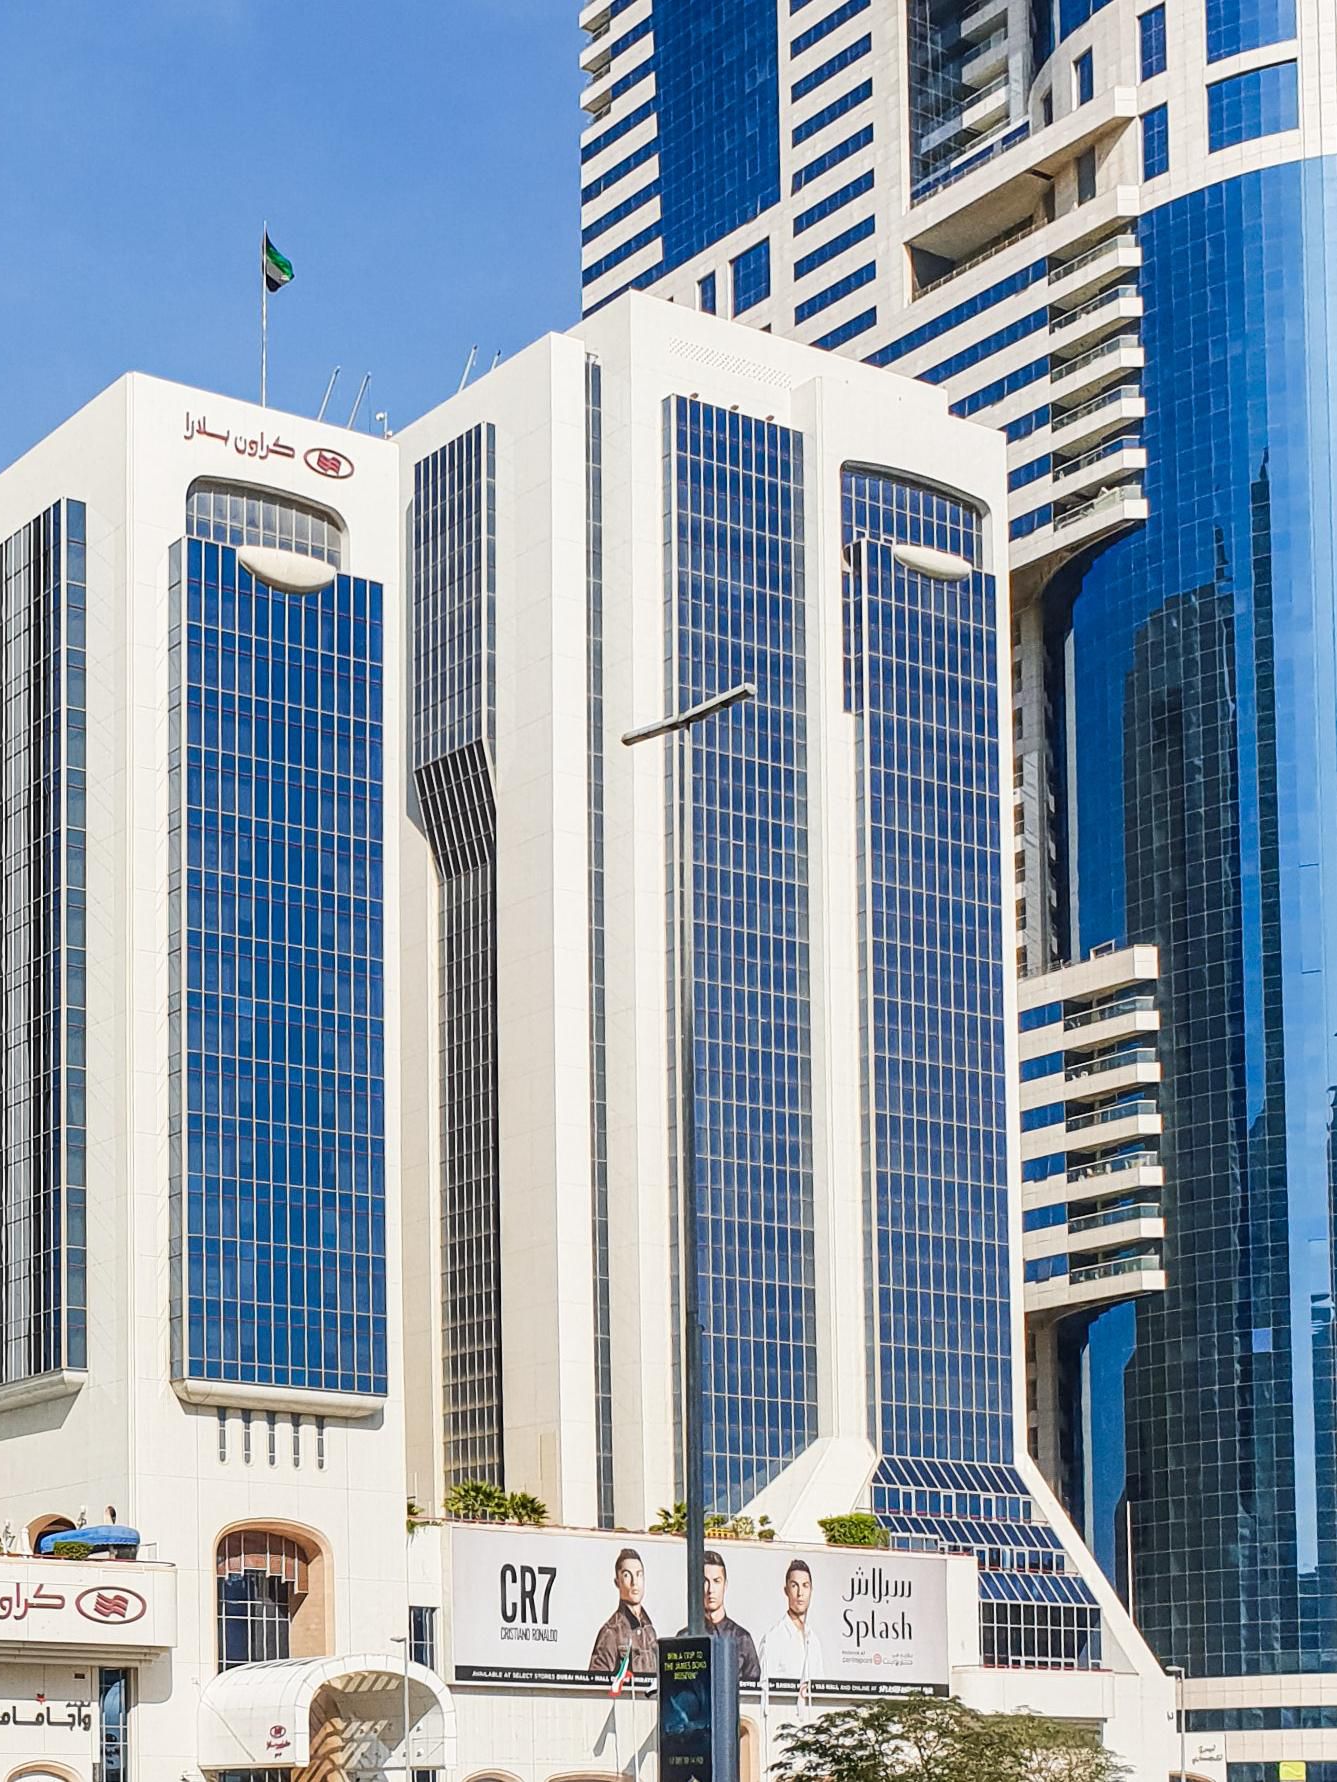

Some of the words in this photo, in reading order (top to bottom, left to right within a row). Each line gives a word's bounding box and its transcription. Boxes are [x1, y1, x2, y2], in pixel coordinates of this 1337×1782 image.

[235, 431, 296, 460] كراون
[500, 1563, 557, 1625] CR7
[500, 1627, 530, 1641] CRISTIANO
[532, 1628, 558, 1643] RONALDO
[842, 1608, 912, 1647] Splash
